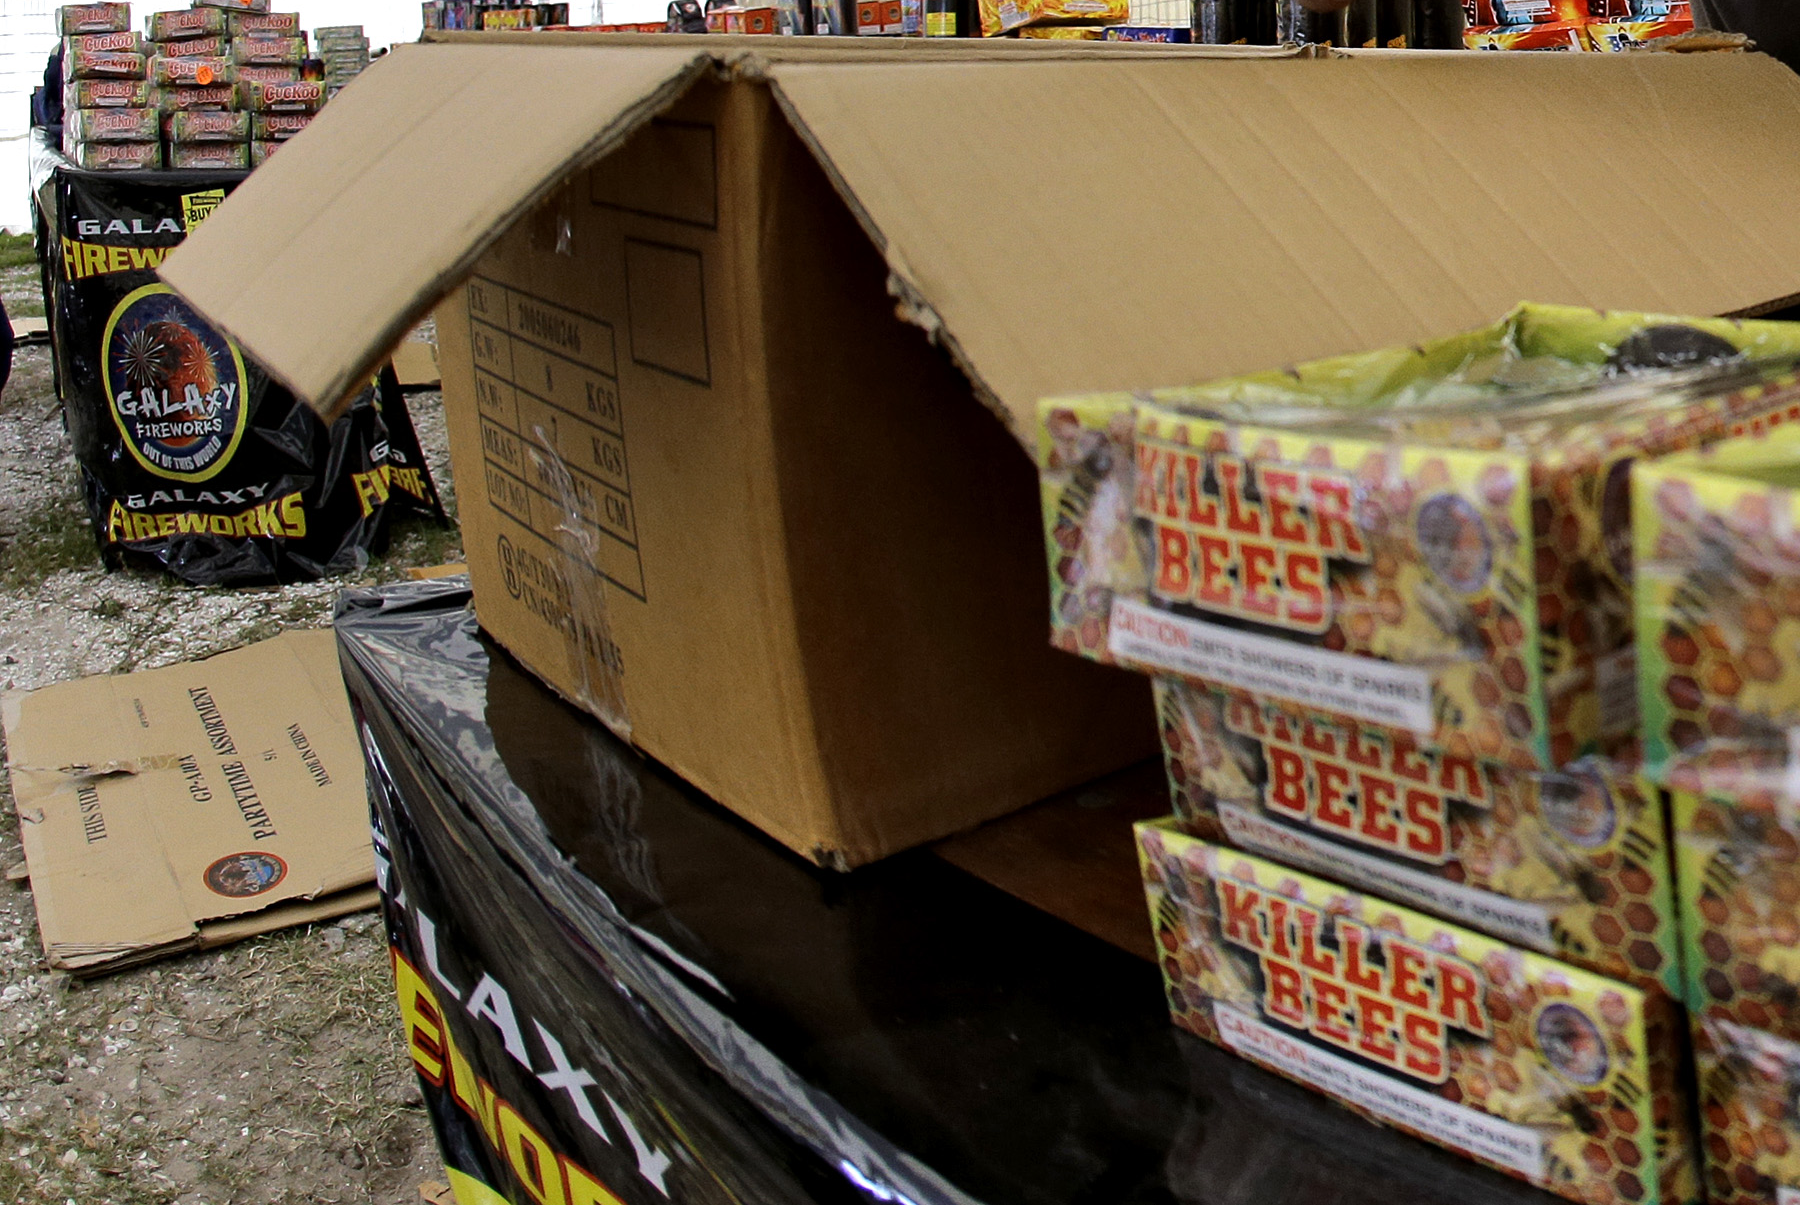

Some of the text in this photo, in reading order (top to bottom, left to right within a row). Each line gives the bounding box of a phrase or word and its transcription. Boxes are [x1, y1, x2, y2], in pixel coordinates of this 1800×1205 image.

[84, 35, 134, 52] CUCKOO
[167, 39, 217, 57] CUCKOO
[242, 15, 293, 31] CUCKOO
[90, 83, 132, 97] CUCKOO
[168, 60, 224, 78] CUCO
[264, 84, 321, 103] CUCKOO
[78, 217, 187, 235] GALA
[116, 382, 237, 419] GALAXY
[585, 380, 616, 423] KGS
[136, 417, 222, 440] FIREWORKS
[143, 437, 222, 471] OUT OF THIS WORLD
[550, 415, 559, 445] 7
[591, 435, 623, 478] KGS
[126, 482, 270, 508] GALAXY
[483, 425, 628, 532] MEAS: CM
[1135, 440, 1373, 564] KILLER
[108, 491, 307, 542] FIREWORKS
[1154, 522, 1332, 634] BEES
[188, 686, 238, 755] ASSORTMENT
[286, 723, 333, 787] MADE IN CHINA
[1224, 694, 1493, 807] KILLER
[77, 783, 107, 844] THIS SIDE
[221, 760, 278, 840] PARTYTIME
[1263, 739, 1448, 865] BEES
[1217, 874, 1495, 1038] KILLER
[1261, 956, 1448, 1085] BEES
